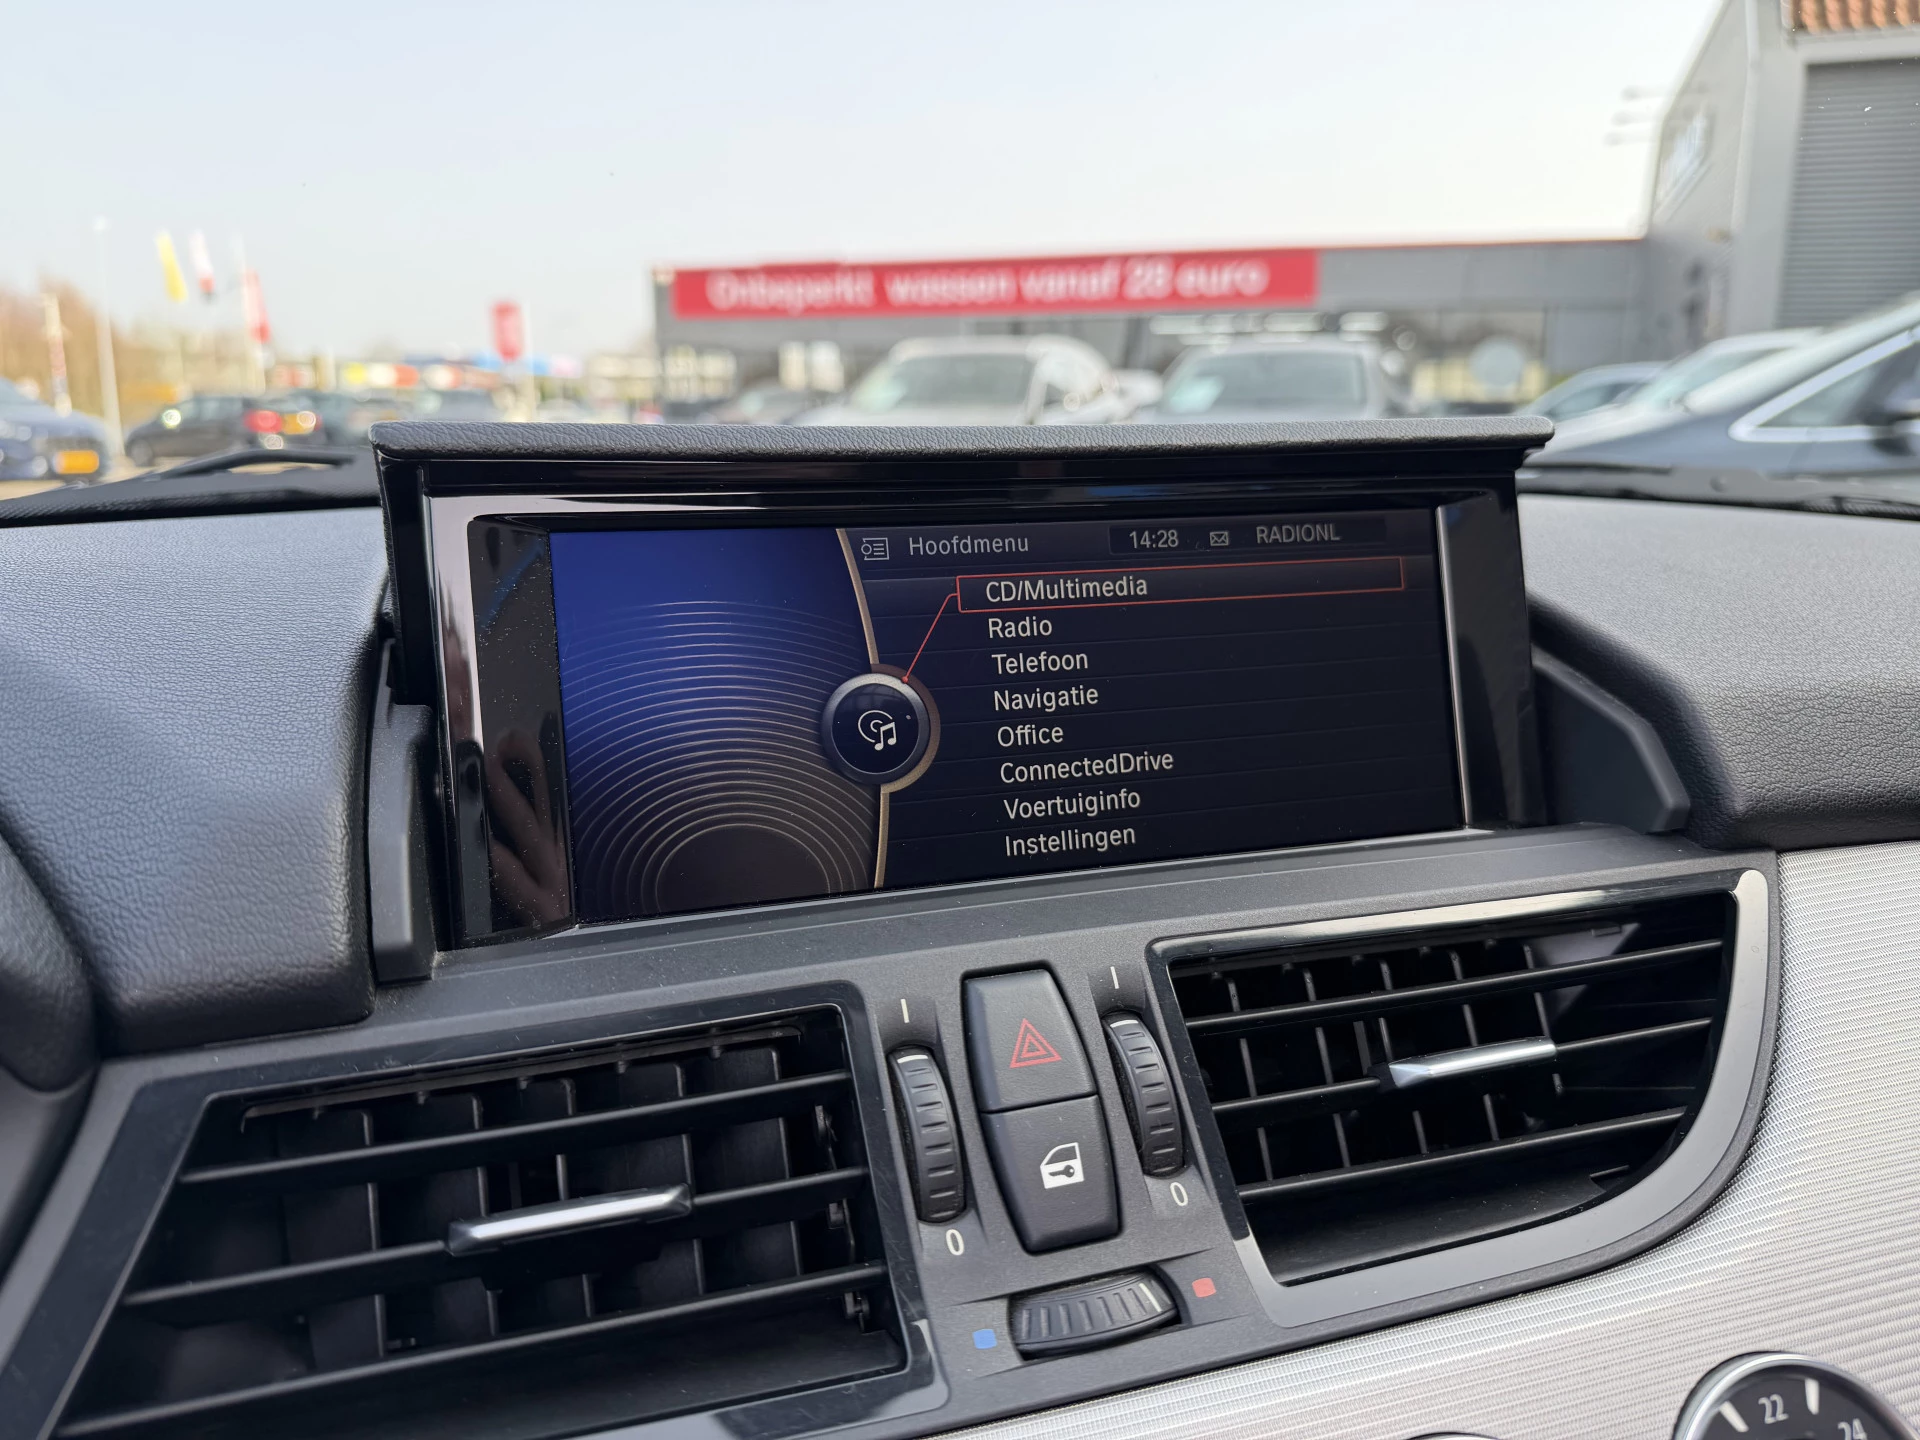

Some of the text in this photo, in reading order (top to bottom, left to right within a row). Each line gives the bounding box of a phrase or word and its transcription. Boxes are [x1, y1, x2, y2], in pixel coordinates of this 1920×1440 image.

[1176, 258, 1270, 297] euro
[908, 534, 1030, 556] Hoofdmenu
[1129, 530, 1179, 549] 14:28
[985, 576, 1148, 603] CD/Multimedia
[988, 617, 1053, 639] Radio
[991, 652, 1089, 675] Telefoon
[994, 685, 1099, 712] Navigatie
[997, 725, 1064, 747] Office
[1000, 751, 1174, 783] ConnectedDrive
[1003, 788, 1141, 820] Voertuiginfo
[1005, 827, 1135, 857] Instellingen
[1758, 1394, 1789, 1424] 22
